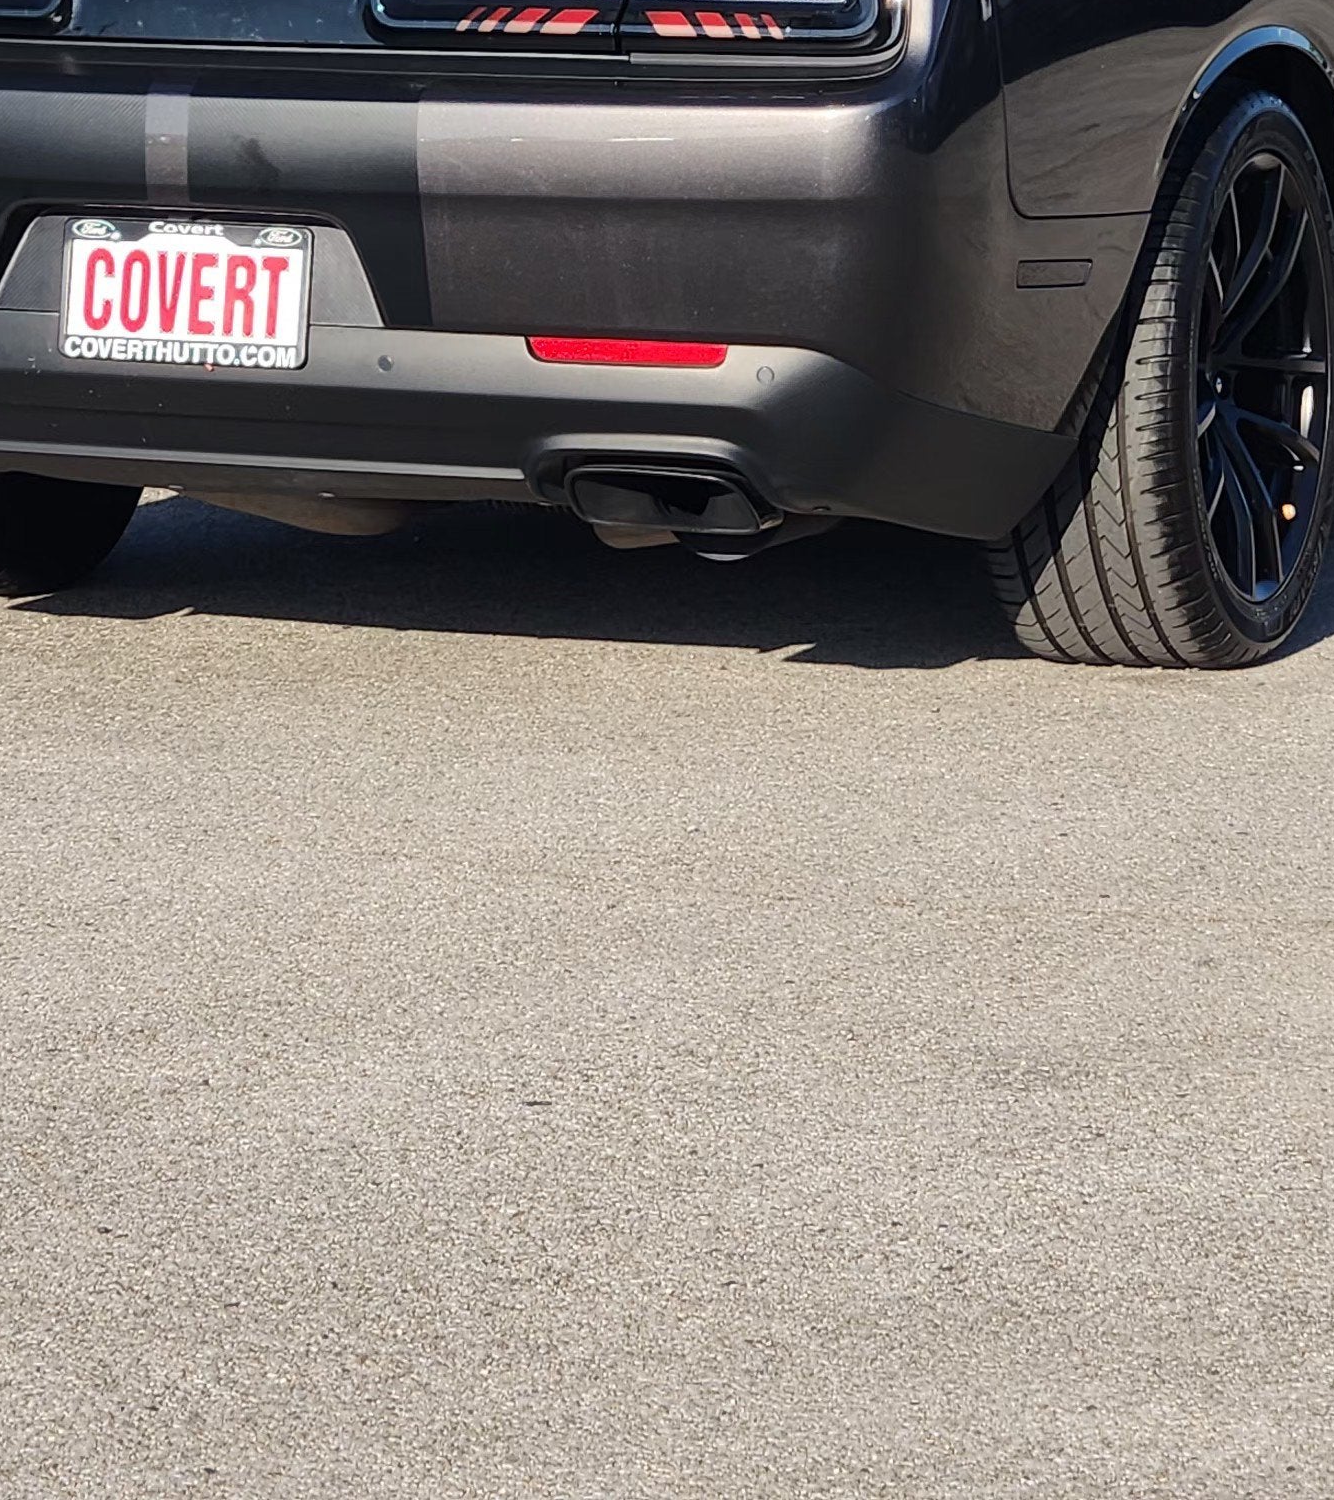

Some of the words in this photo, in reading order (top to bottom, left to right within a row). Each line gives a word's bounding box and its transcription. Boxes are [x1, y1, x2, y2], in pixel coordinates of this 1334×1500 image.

[147, 220, 224, 236] Covert
[83, 247, 290, 339] COVERT
[64, 336, 297, 369] COVERTHUTTO.COM
